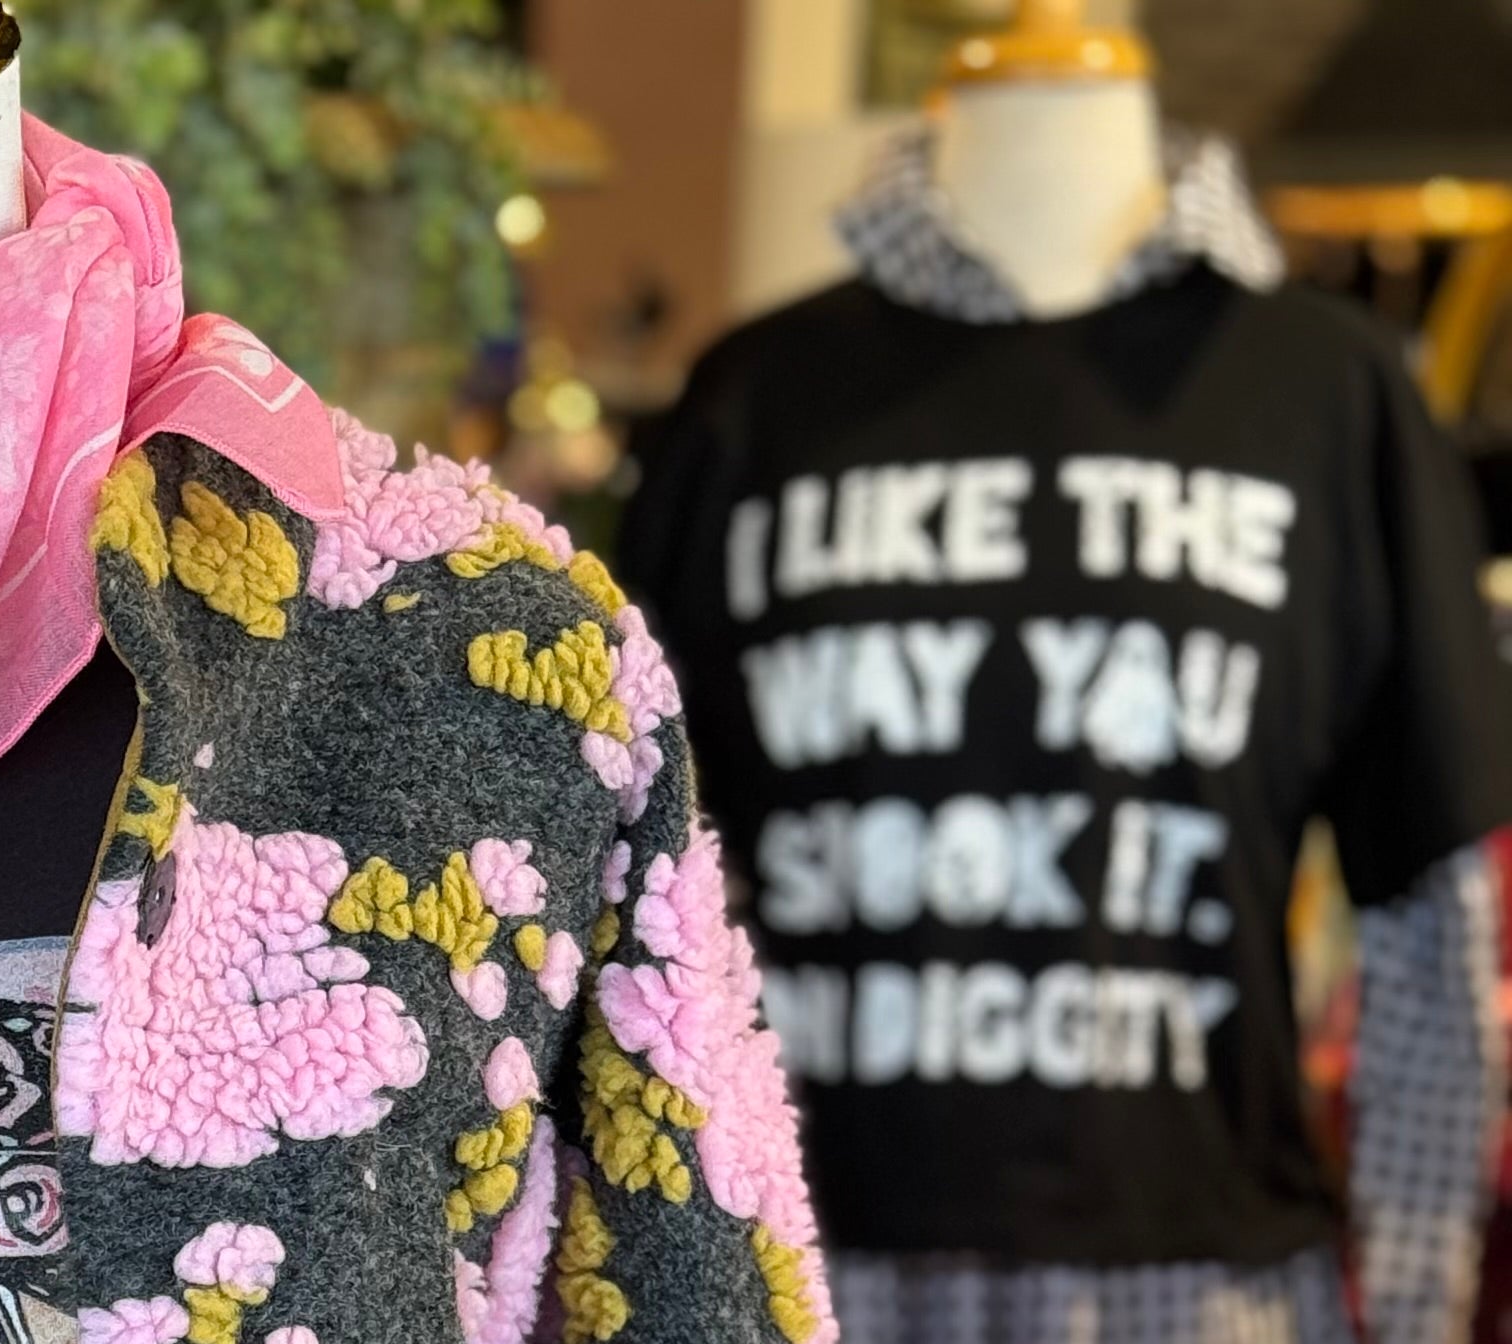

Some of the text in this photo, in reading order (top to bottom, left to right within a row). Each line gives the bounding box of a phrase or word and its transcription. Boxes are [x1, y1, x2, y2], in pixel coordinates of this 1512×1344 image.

[728, 456, 1296, 618] I LIKE THE
[741, 616, 1260, 774] WAY YOU
[1102, 799, 1231, 944] IT.
[852, 960, 1236, 1090] DIGGITY
